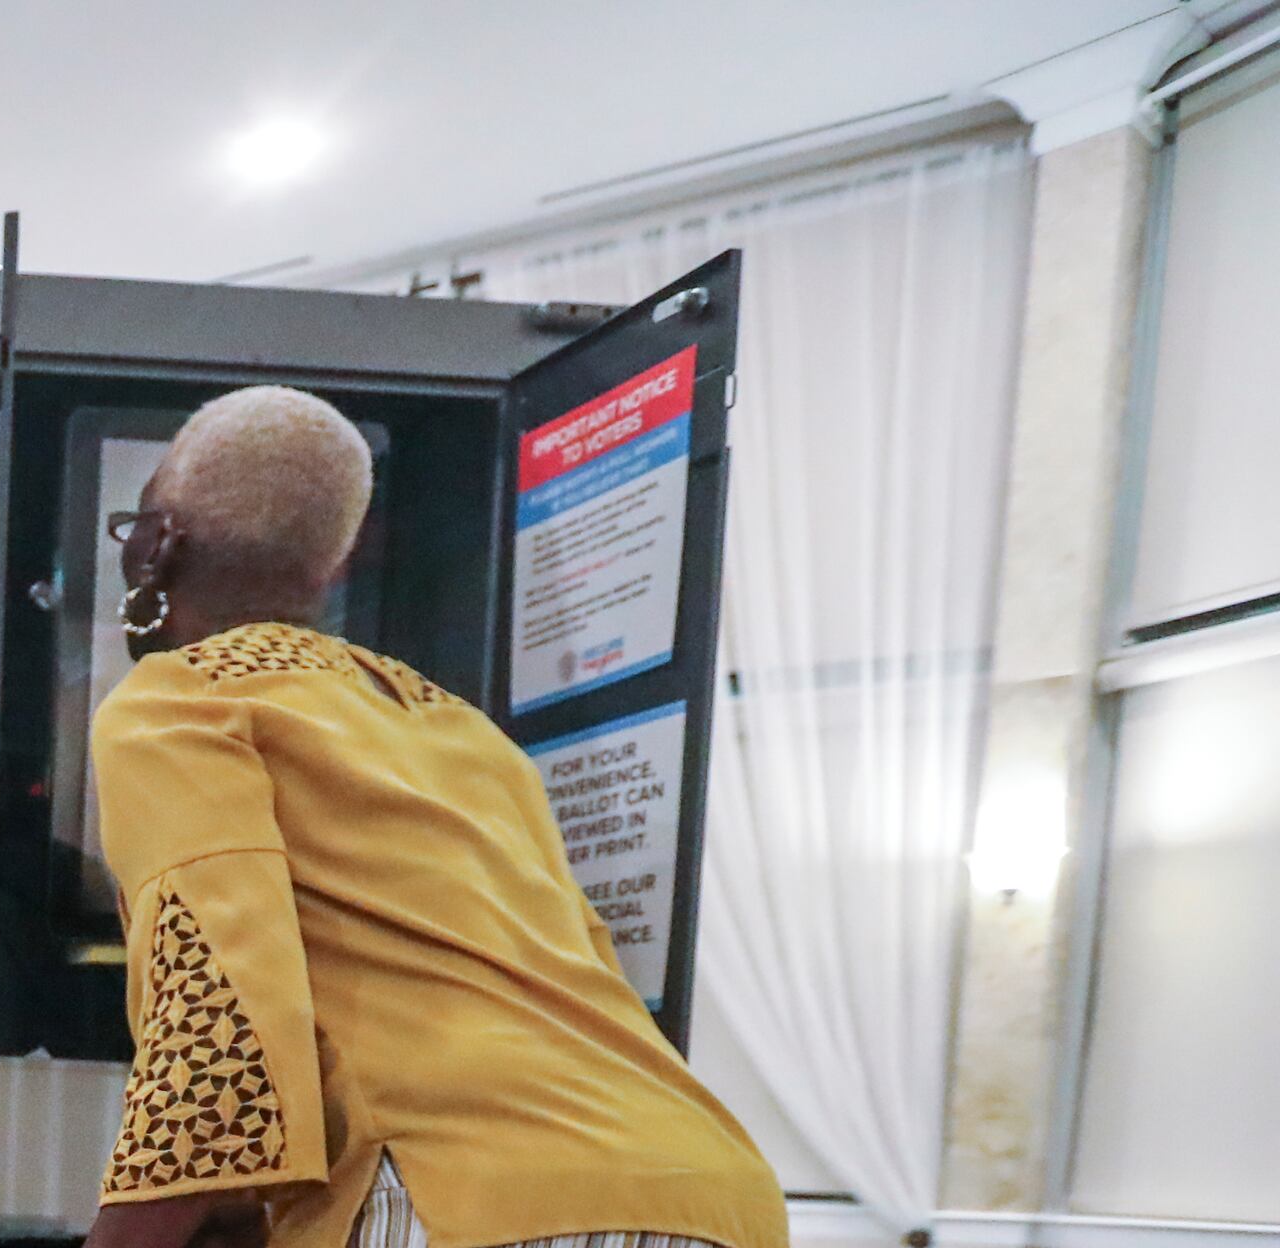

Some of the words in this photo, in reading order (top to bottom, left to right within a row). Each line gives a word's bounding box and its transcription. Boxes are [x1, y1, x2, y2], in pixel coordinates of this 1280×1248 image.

[532, 399, 619, 458] IMPORTANT
[618, 368, 679, 416] NOTICE
[561, 441, 585, 466] TO
[584, 410, 644, 453] VOTERS
[551, 757, 584, 780] FOR
[589, 741, 638, 769] YOUR
[557, 792, 620, 823] BALLOT
[626, 783, 665, 806] CAN
[627, 810, 647, 828] IN
[617, 873, 657, 897] OUR
